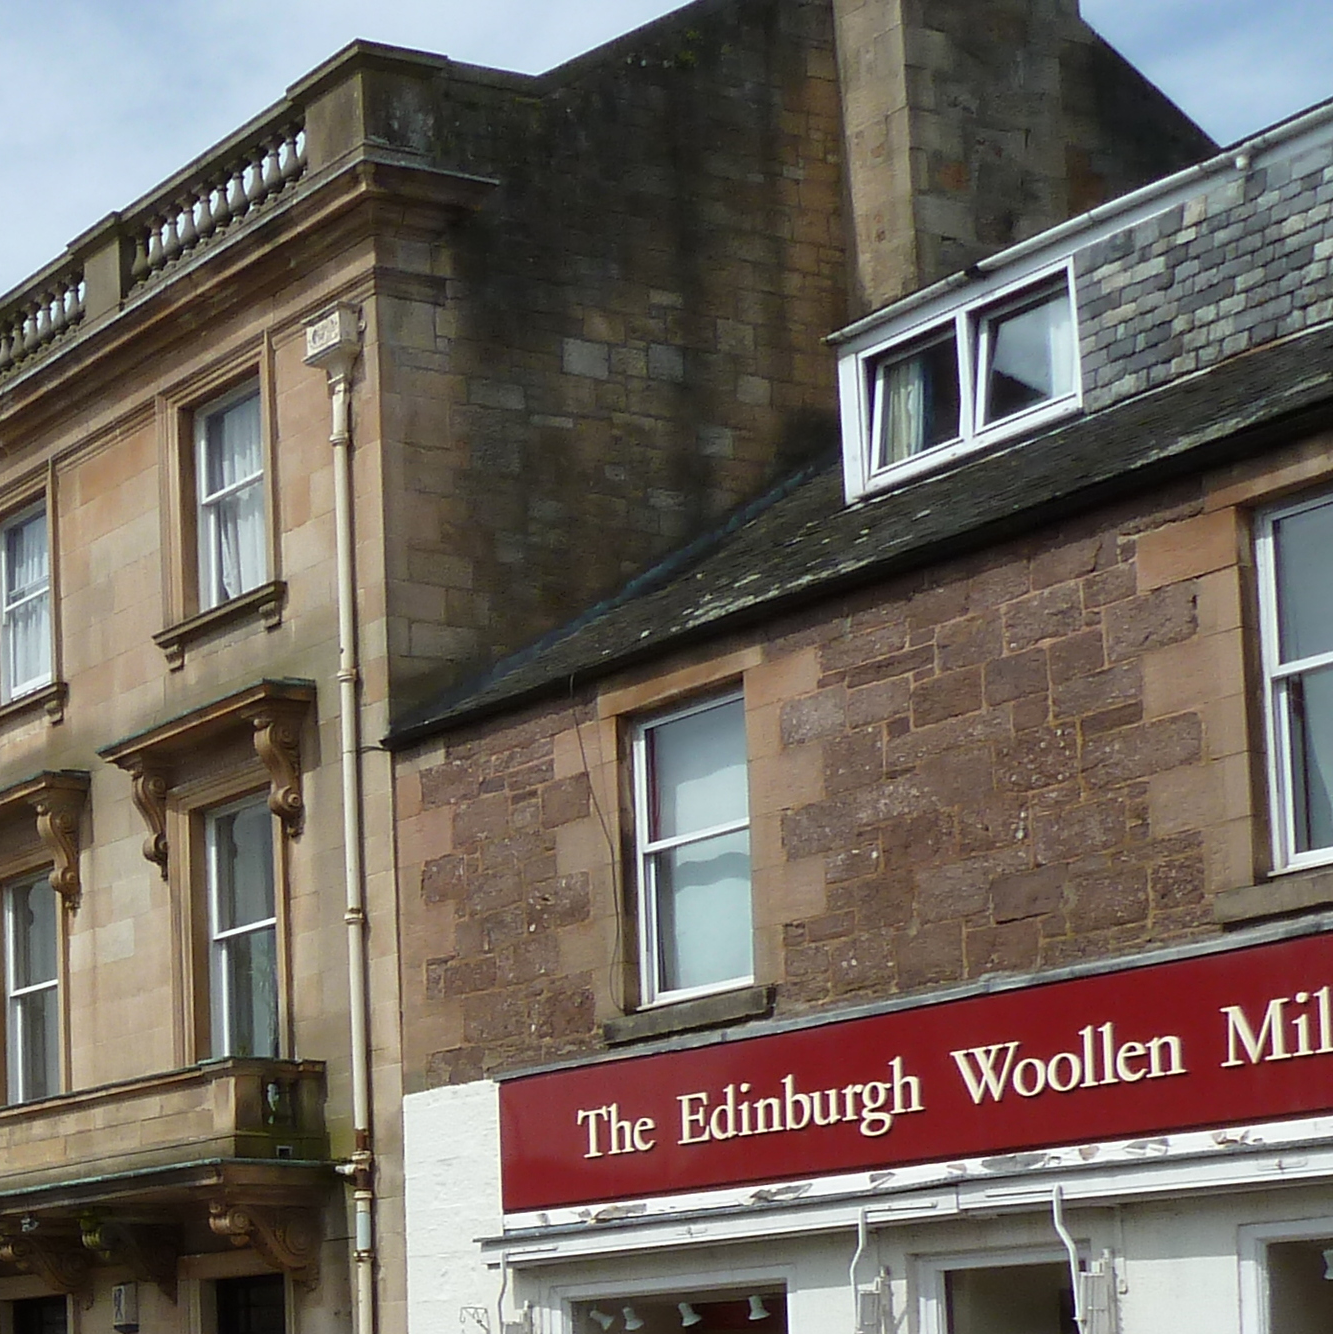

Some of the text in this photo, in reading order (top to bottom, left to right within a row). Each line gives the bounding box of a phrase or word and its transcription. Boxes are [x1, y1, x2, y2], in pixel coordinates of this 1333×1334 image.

[577, 1103, 655, 1158] The
[676, 1056, 926, 1146] Edinburgh
[950, 1021, 1188, 1105] Woollen
